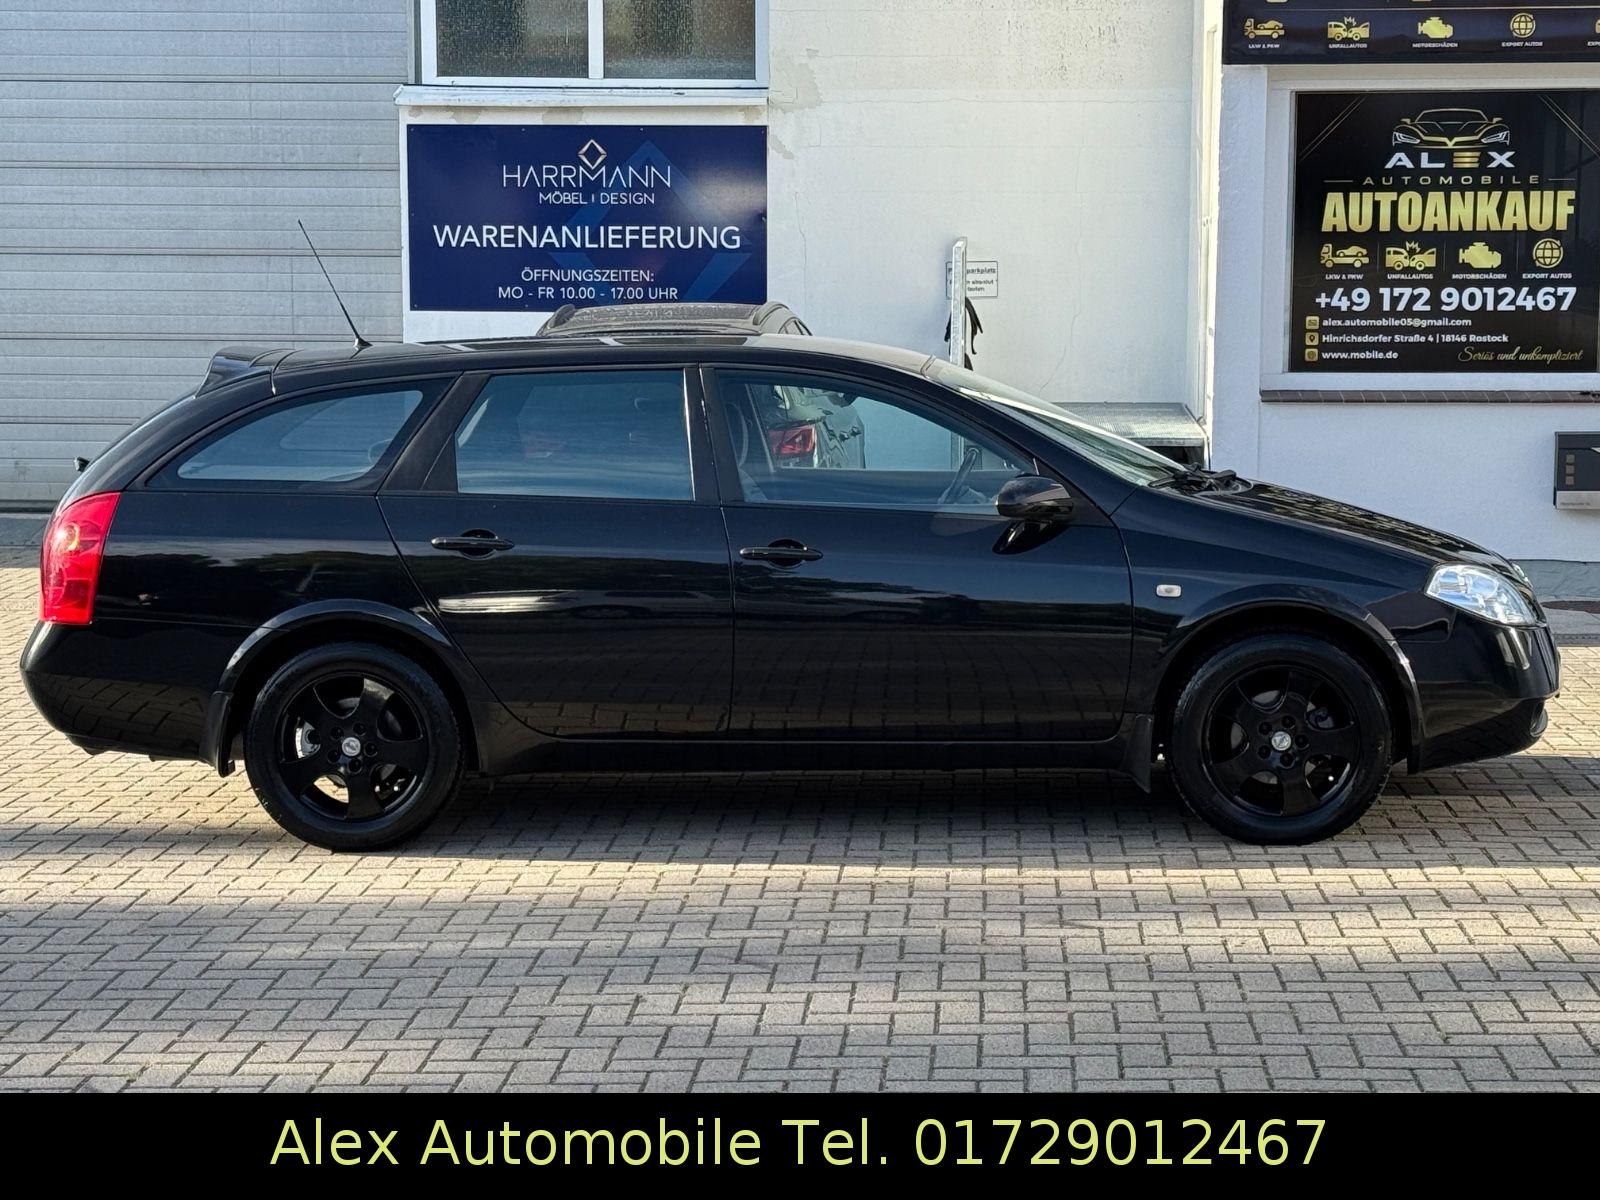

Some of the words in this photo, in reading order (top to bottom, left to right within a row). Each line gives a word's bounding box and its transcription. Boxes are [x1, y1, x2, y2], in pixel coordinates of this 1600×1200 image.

[1384, 151, 1516, 169] ALEX
[503, 164, 671, 188] HARRMANN
[1362, 175, 1540, 186] AUTOMOBILE
[539, 190, 588, 205] MÖBEL
[600, 192, 655, 205] DESIGN
[1322, 191, 1575, 232] AUTOANKAUF
[432, 224, 741, 249] WARENANLIEFERUNG
[521, 266, 654, 282] ÖFFNUNGSZEITEN:
[1451, 272, 1507, 280] MOTORSCHÄDEN
[498, 286, 524, 299] MO
[537, 286, 555, 299] FR
[559, 286, 596, 299] 10.00
[610, 286, 644, 300] 17.00
[648, 287, 678, 300] UHR
[1315, 287, 1371, 312] +49
[1378, 287, 1431, 312] 172
[1440, 286, 1577, 312] 9012467
[1322, 317, 1472, 330] alex.automobile05@gmail.com
[1322, 333, 1393, 343] Hinrichsdorfer
[1393, 333, 1426, 343] Straße
[1427, 334, 1434, 343] 4
[1440, 334, 1467, 343] 18146
[1469, 333, 1509, 343] Rostock
[1321, 350, 1399, 359] www.mobile.de
[1496, 346, 1517, 361] und
